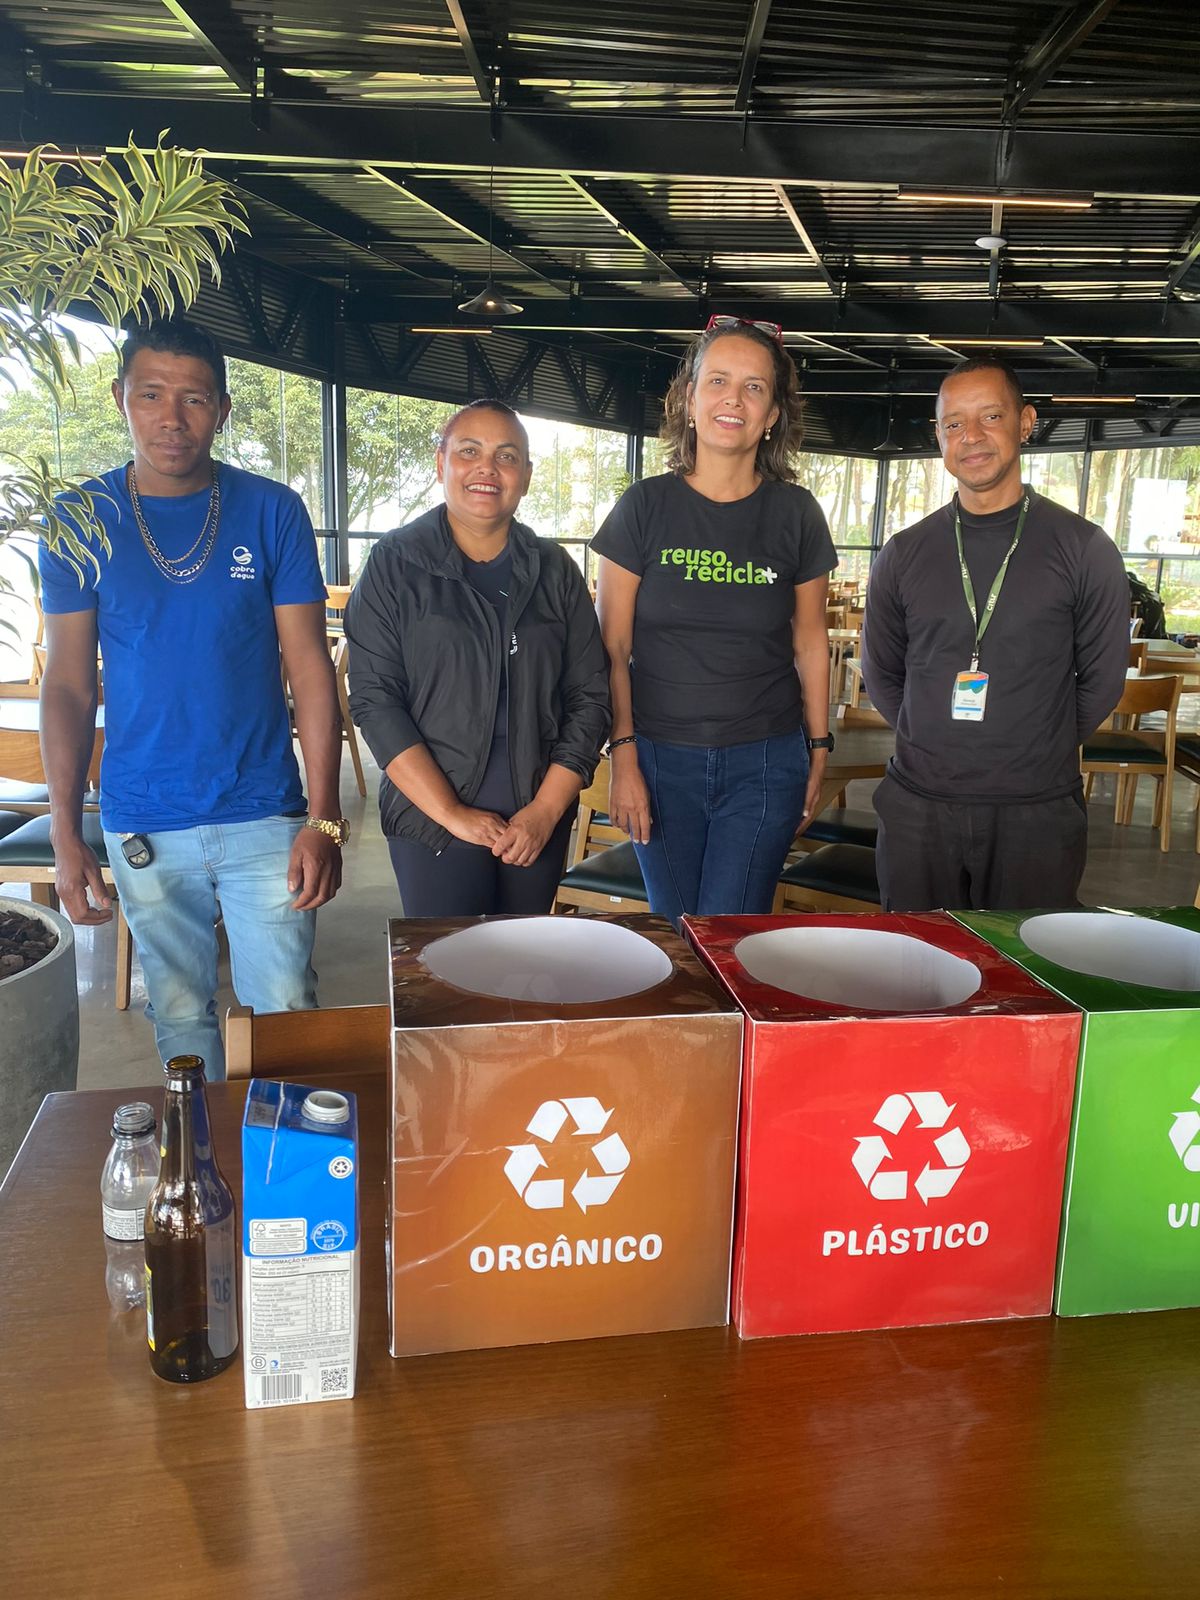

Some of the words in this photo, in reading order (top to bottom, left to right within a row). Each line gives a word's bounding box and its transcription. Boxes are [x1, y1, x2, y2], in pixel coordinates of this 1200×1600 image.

[229, 565, 256, 573] cobra
[660, 547, 727, 566] reuso
[822, 1221, 989, 1257] PLÁSTICO
[469, 1233, 663, 1274] ORGÂNICO
